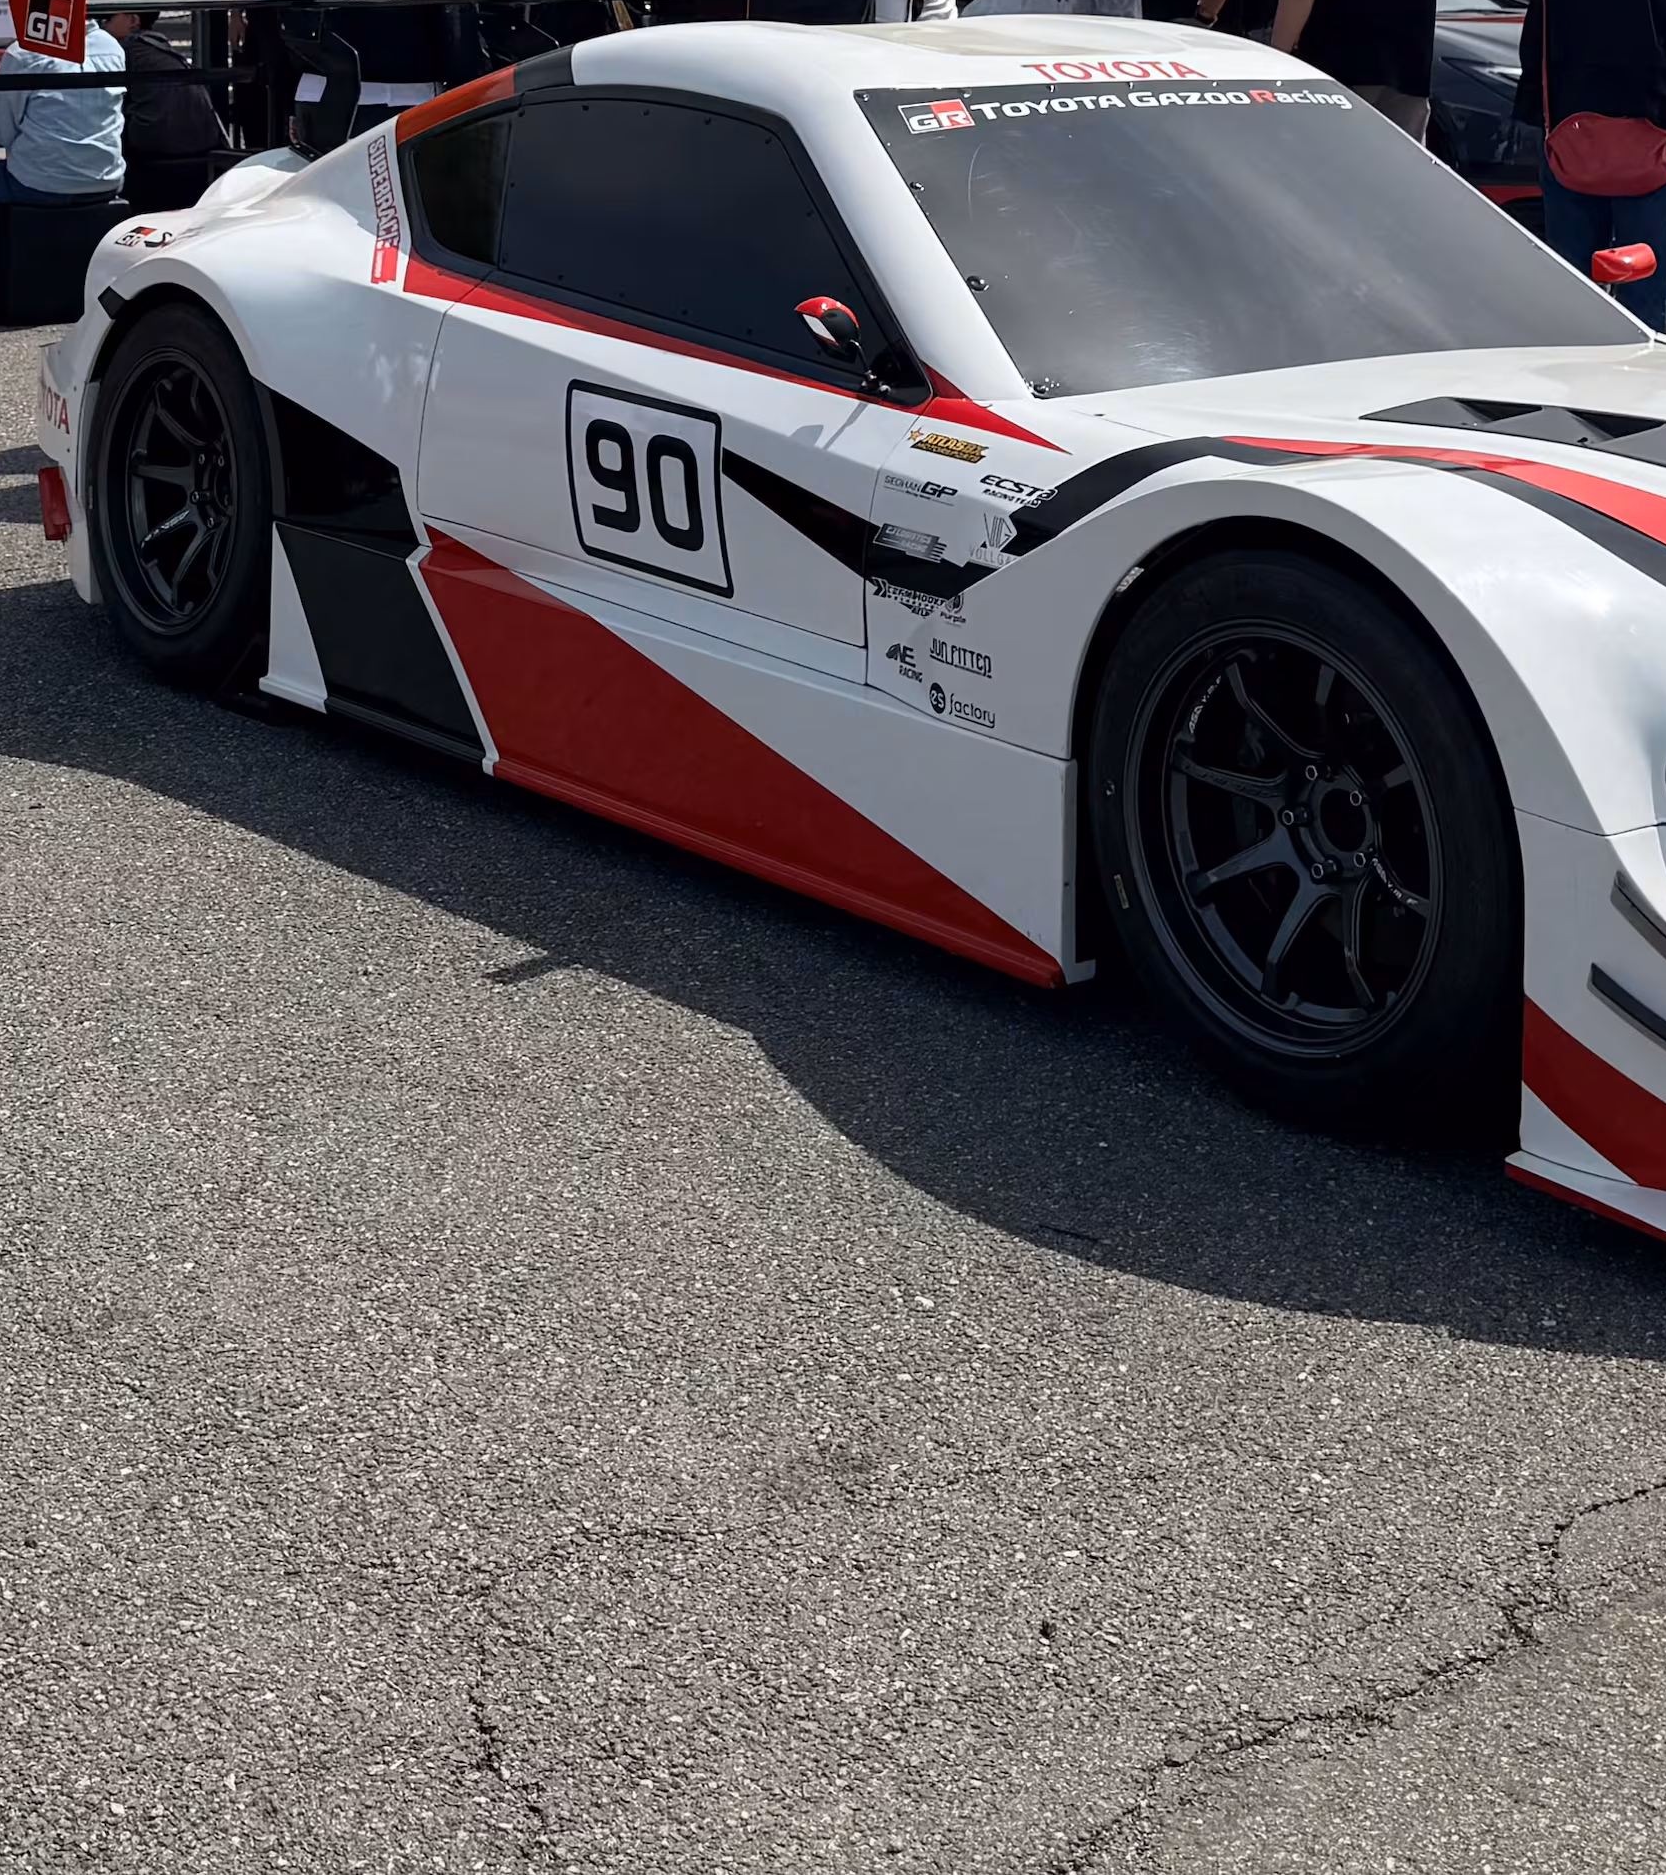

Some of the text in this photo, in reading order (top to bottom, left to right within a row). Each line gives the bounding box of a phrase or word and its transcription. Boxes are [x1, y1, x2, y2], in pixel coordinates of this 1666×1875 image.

[27, 11, 69, 45] GR
[1022, 60, 1209, 83] TOYOTA
[909, 89, 1353, 133] GR TOYOTA GAZOO Racing
[585, 418, 705, 552] 90
[921, 481, 958, 498] GP
[948, 693, 995, 729] factory
